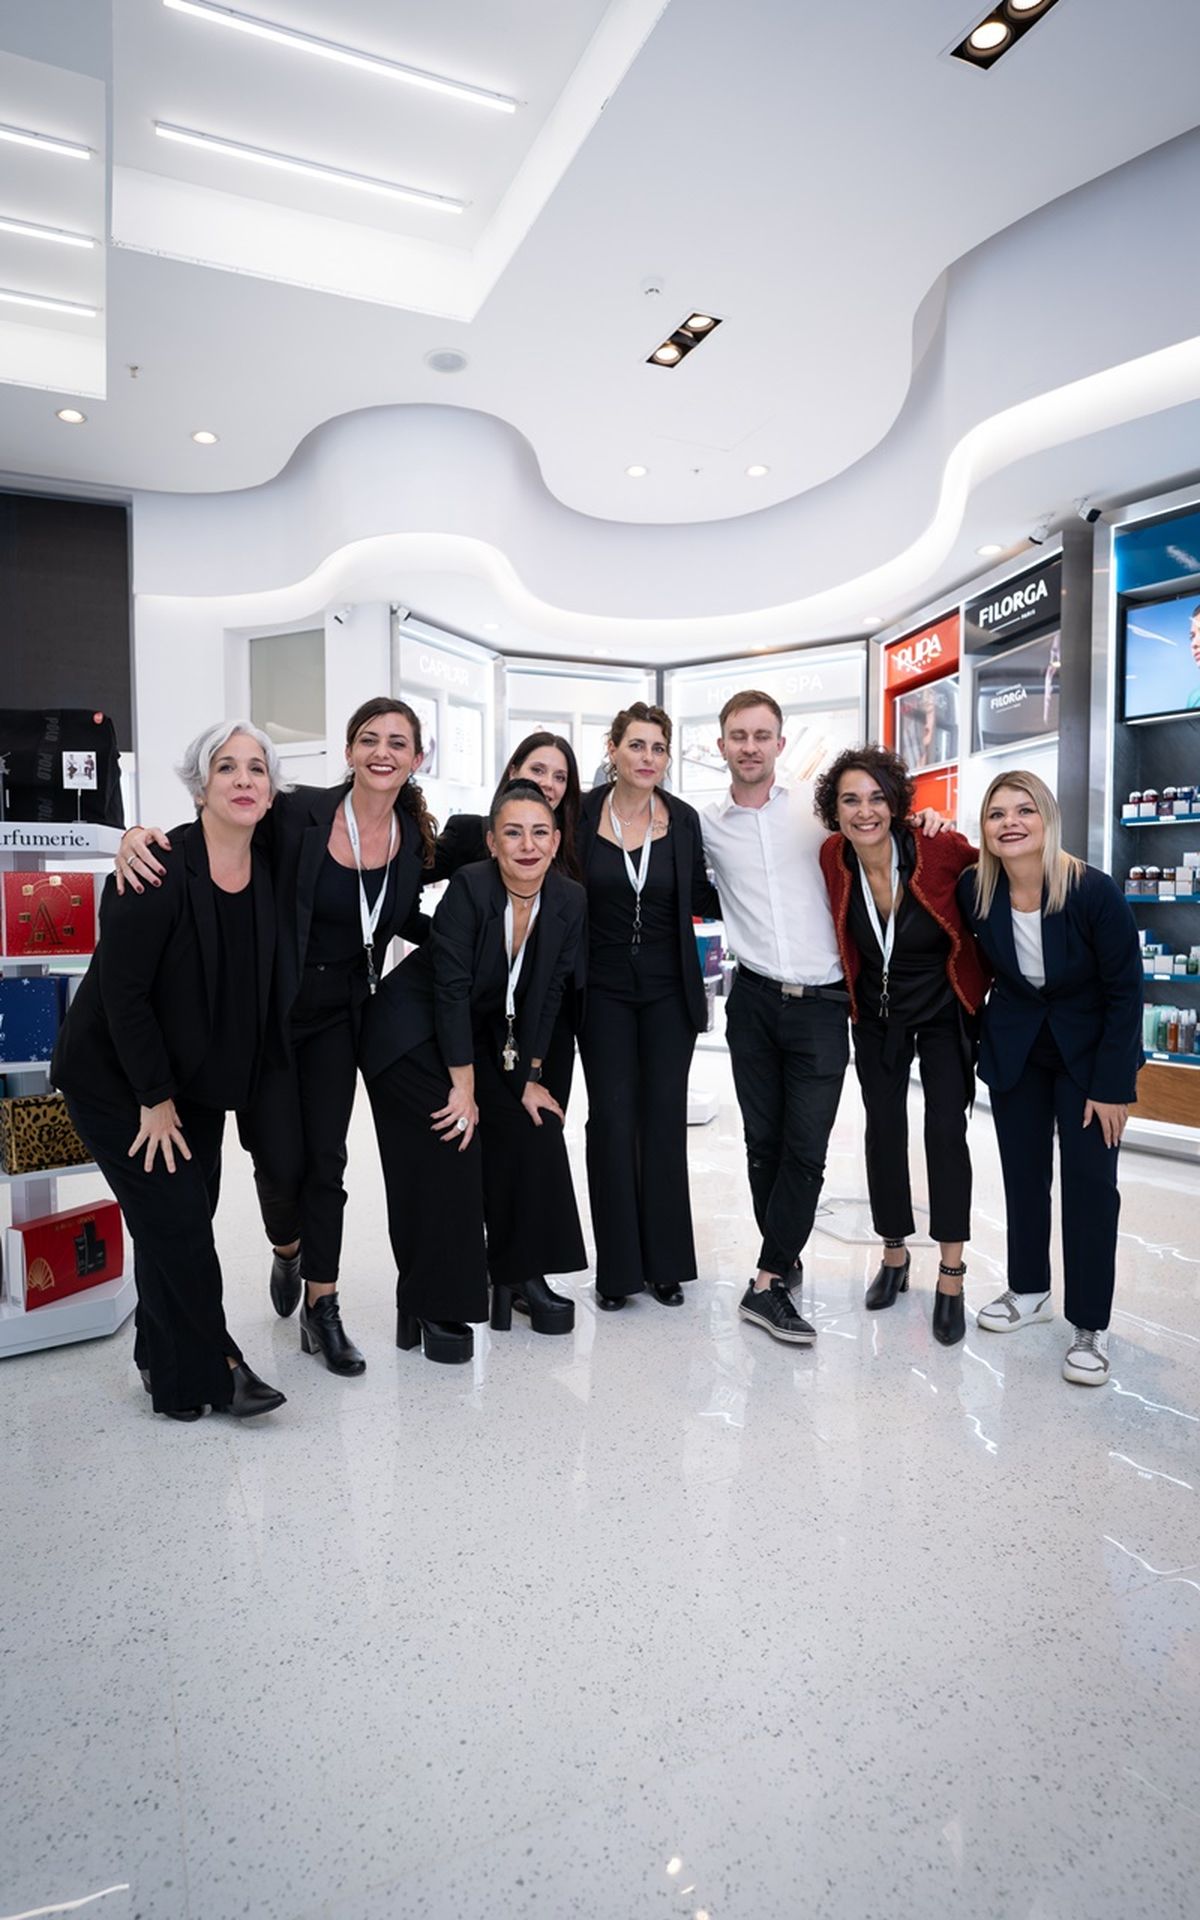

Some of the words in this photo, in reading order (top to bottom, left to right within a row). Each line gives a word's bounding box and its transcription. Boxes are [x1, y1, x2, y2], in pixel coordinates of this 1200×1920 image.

[978, 579, 1048, 628] FILORGA
[891, 633, 943, 672] PUPA
[785, 673, 824, 696] SPA
[990, 688, 1028, 710] FILORGA
[44, 716, 60, 742] POLO
[36, 752, 53, 781] POLO
[37, 797, 54, 821] POL
[0, 829, 90, 847] rfumerie.
